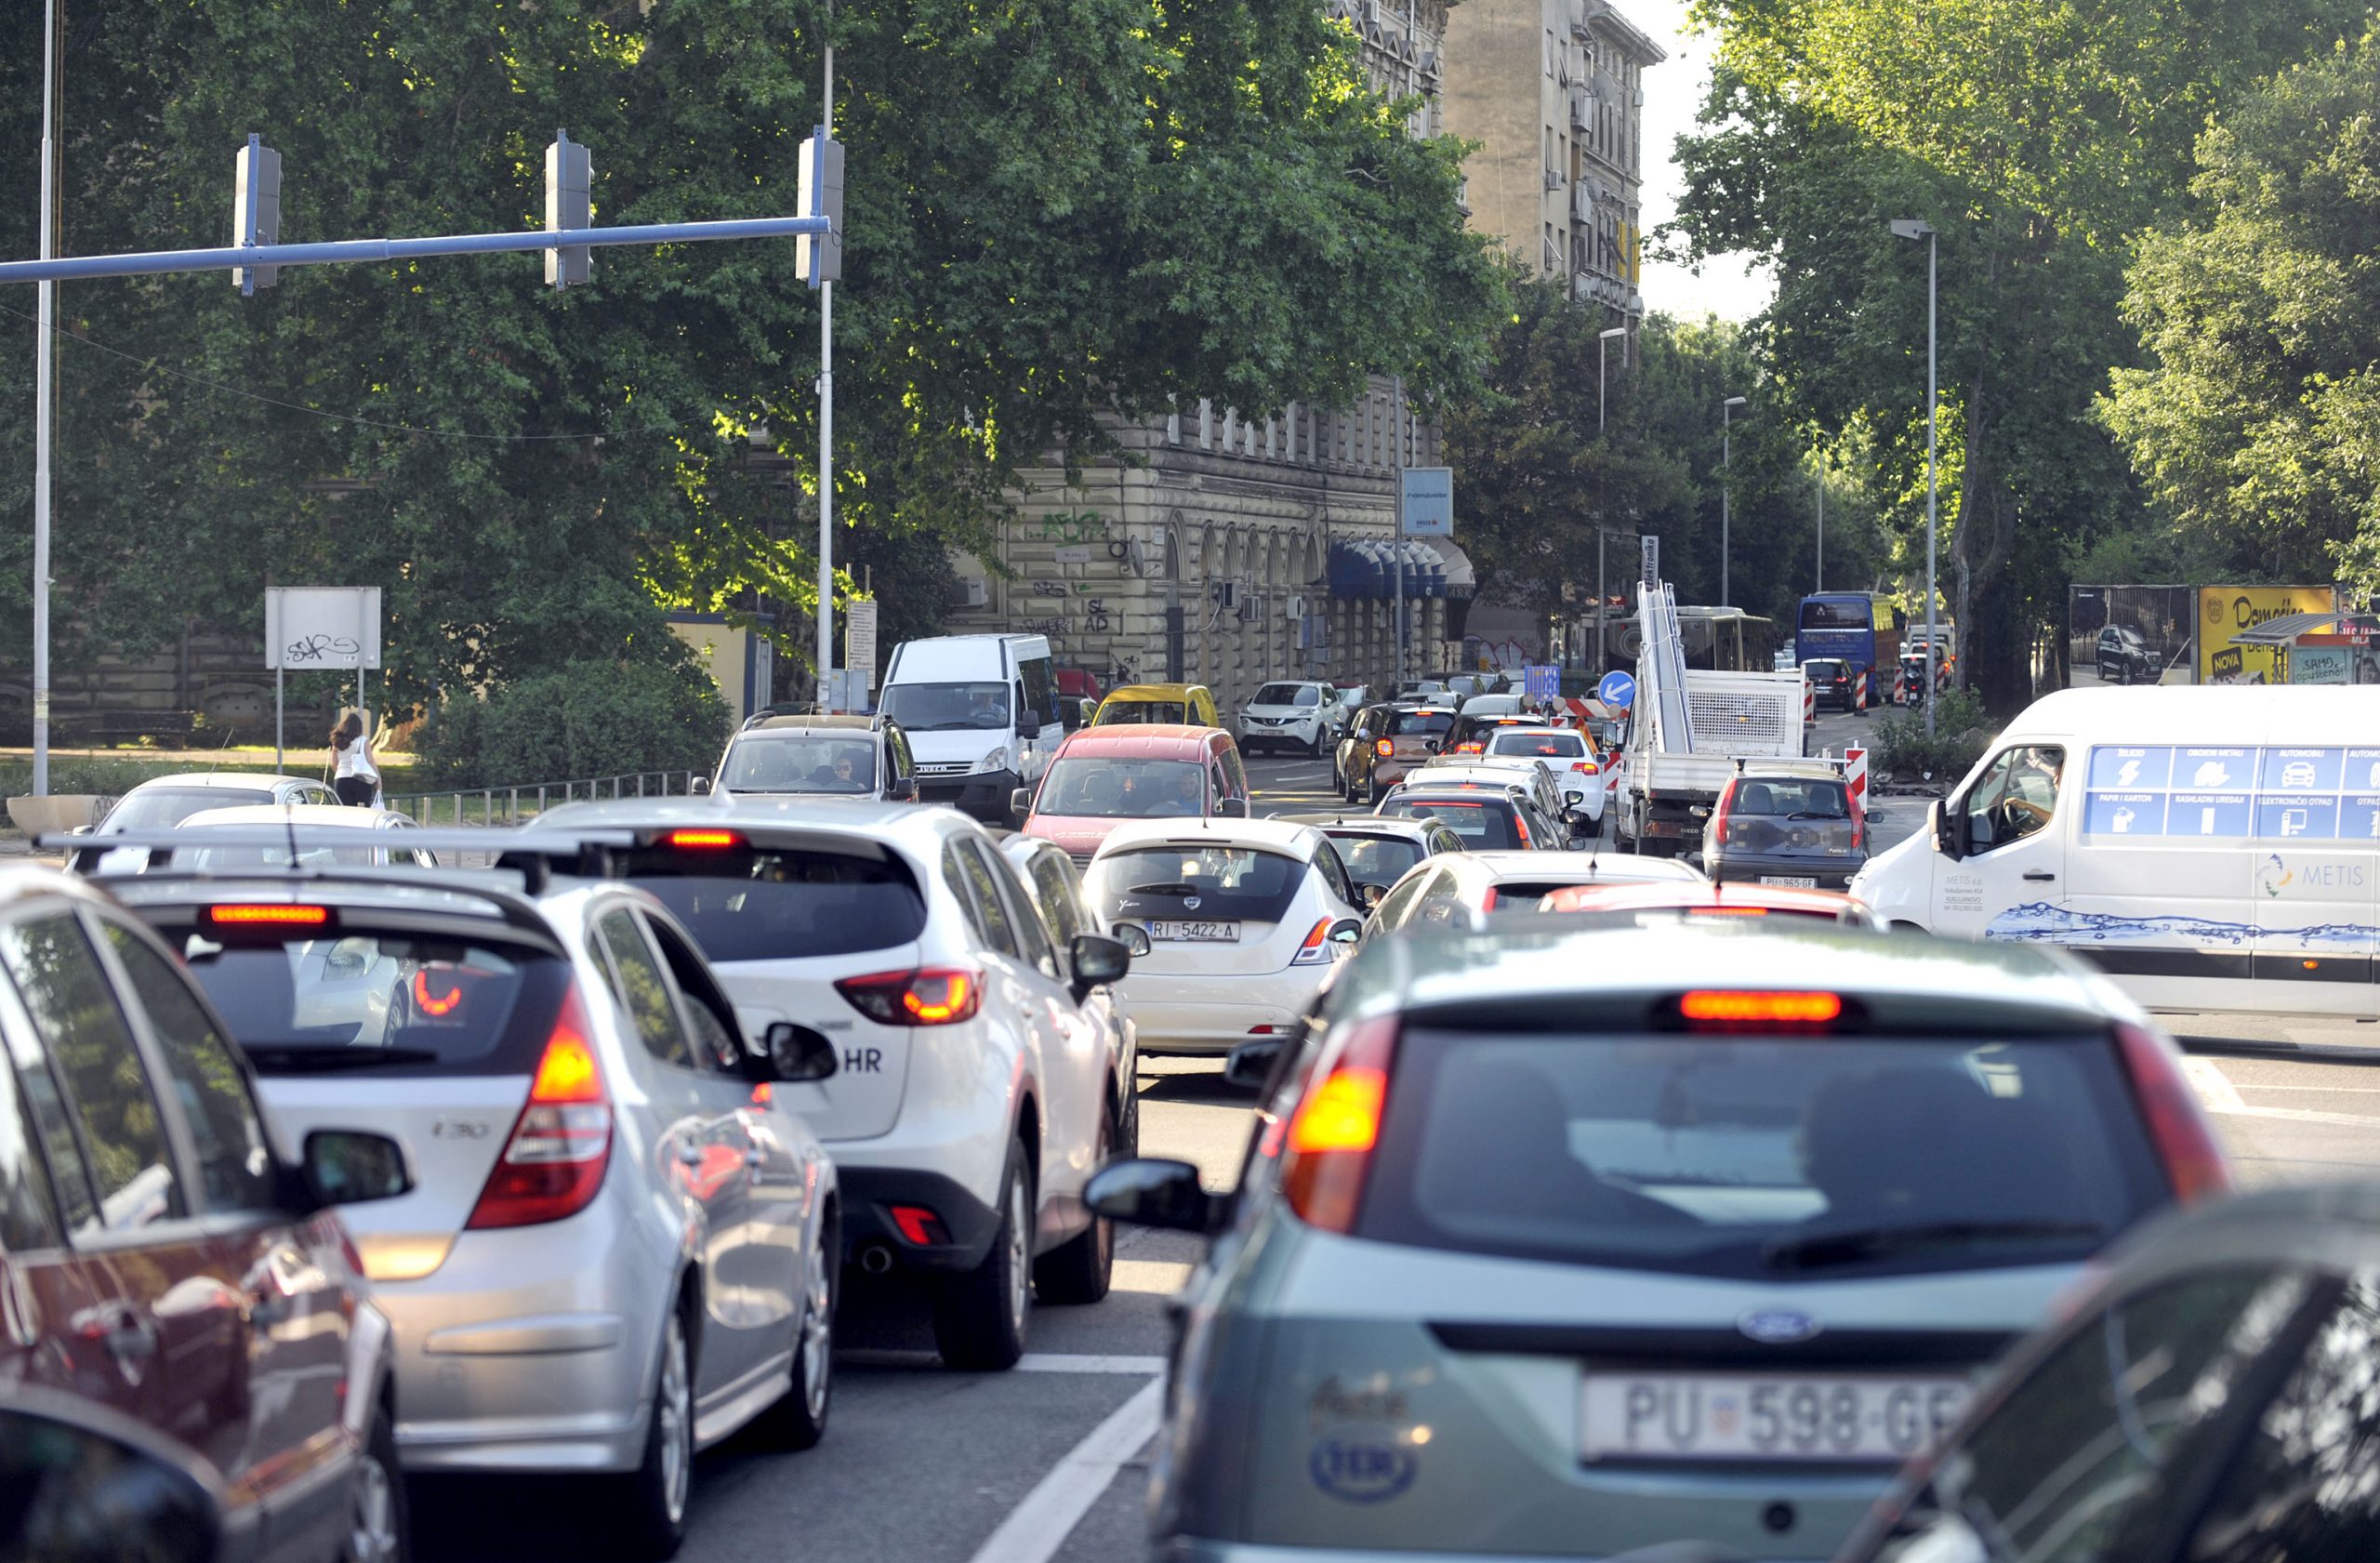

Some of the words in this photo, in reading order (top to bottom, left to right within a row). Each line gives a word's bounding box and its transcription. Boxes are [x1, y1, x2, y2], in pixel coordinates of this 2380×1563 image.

[1645, 539, 1654, 586] Elektronika
[2350, 635, 2370, 644] MLA
[2215, 654, 2240, 671] NOVA
[2219, 748, 2245, 758] METALI
[2279, 749, 2325, 758] AUTOMOBILI
[2099, 794, 2119, 802] PAPIR
[2123, 795, 2153, 803] KARTON
[2175, 795, 2215, 803] RASHLADNI
[2308, 797, 2334, 806] OTPAD
[1945, 875, 1971, 885] METIS
[2303, 865, 2364, 886] METIS
[1154, 922, 1170, 937] RI
[1182, 922, 1233, 937] 5422-A
[844, 1048, 882, 1072] HR
[1625, 1382, 1701, 1450] PU
